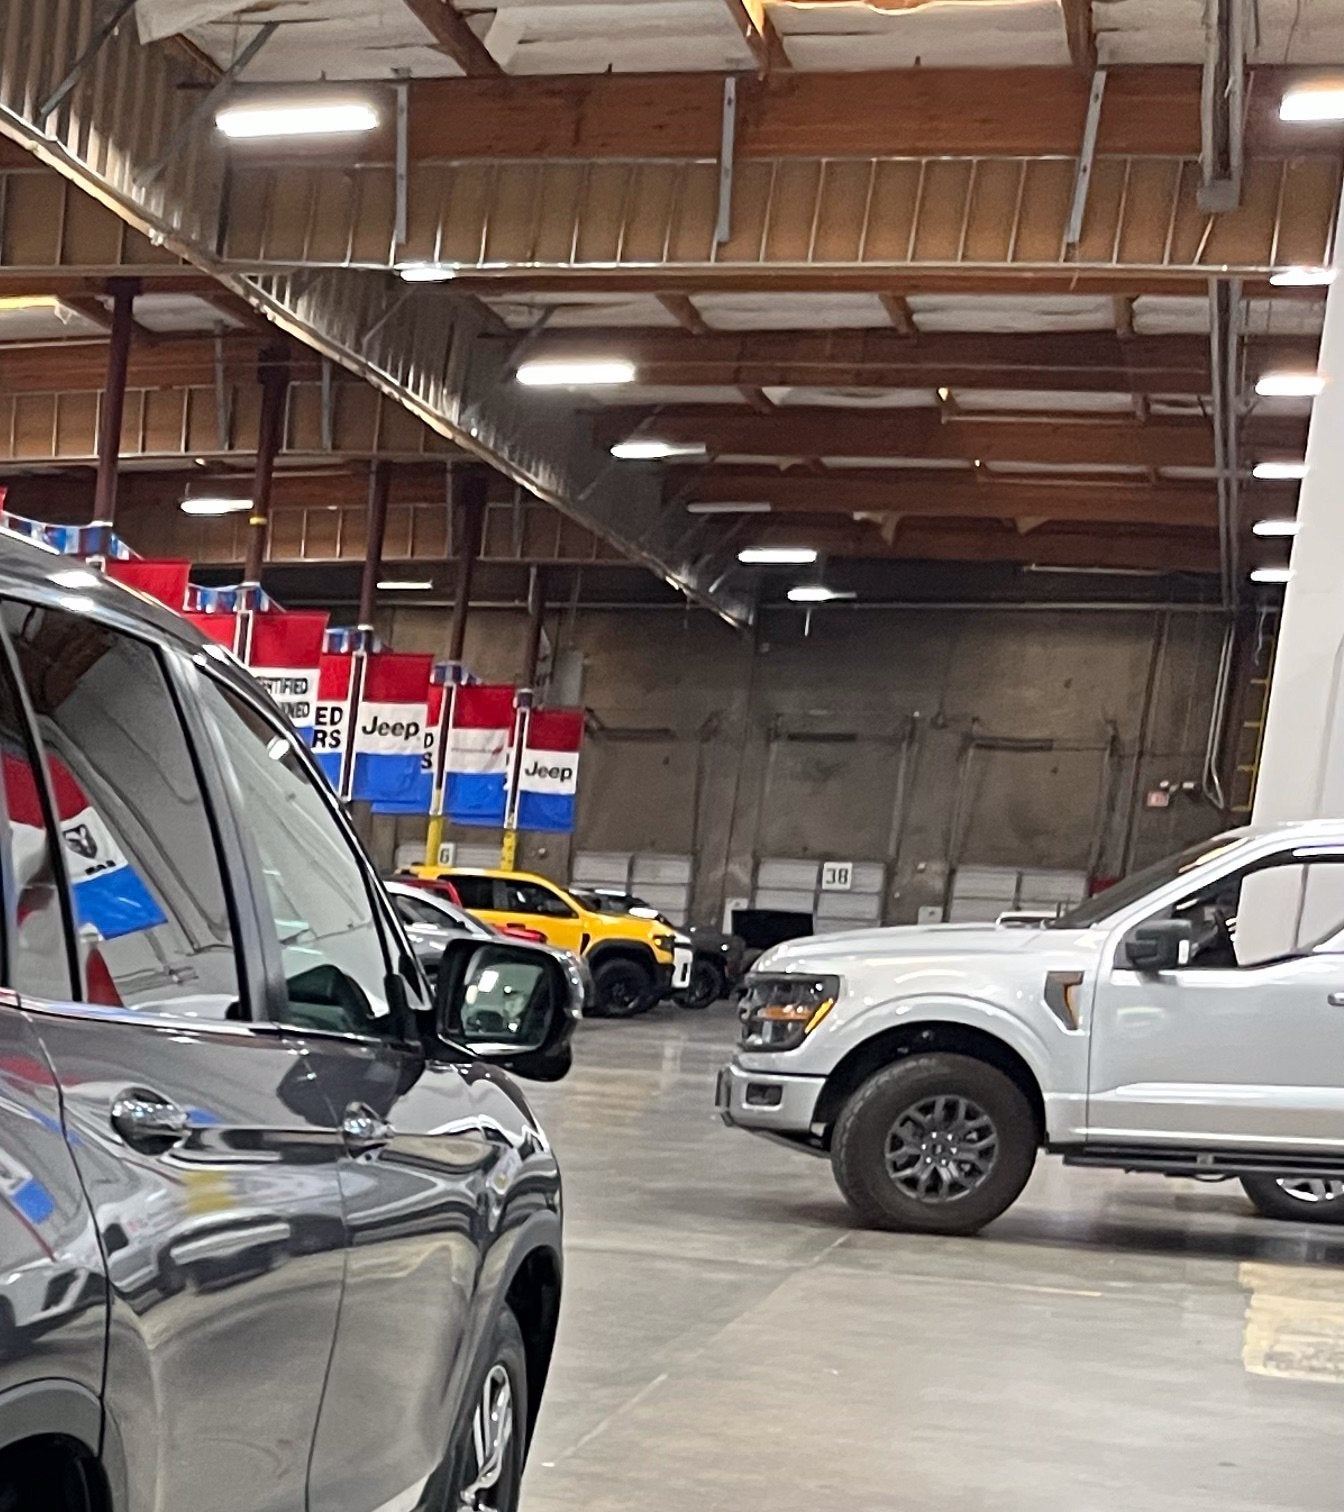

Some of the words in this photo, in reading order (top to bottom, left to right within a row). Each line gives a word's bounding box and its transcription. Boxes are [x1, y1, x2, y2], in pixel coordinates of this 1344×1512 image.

[362, 715, 421, 741] Jeep
[524, 761, 573, 782] Jeep
[825, 867, 849, 885] 38
